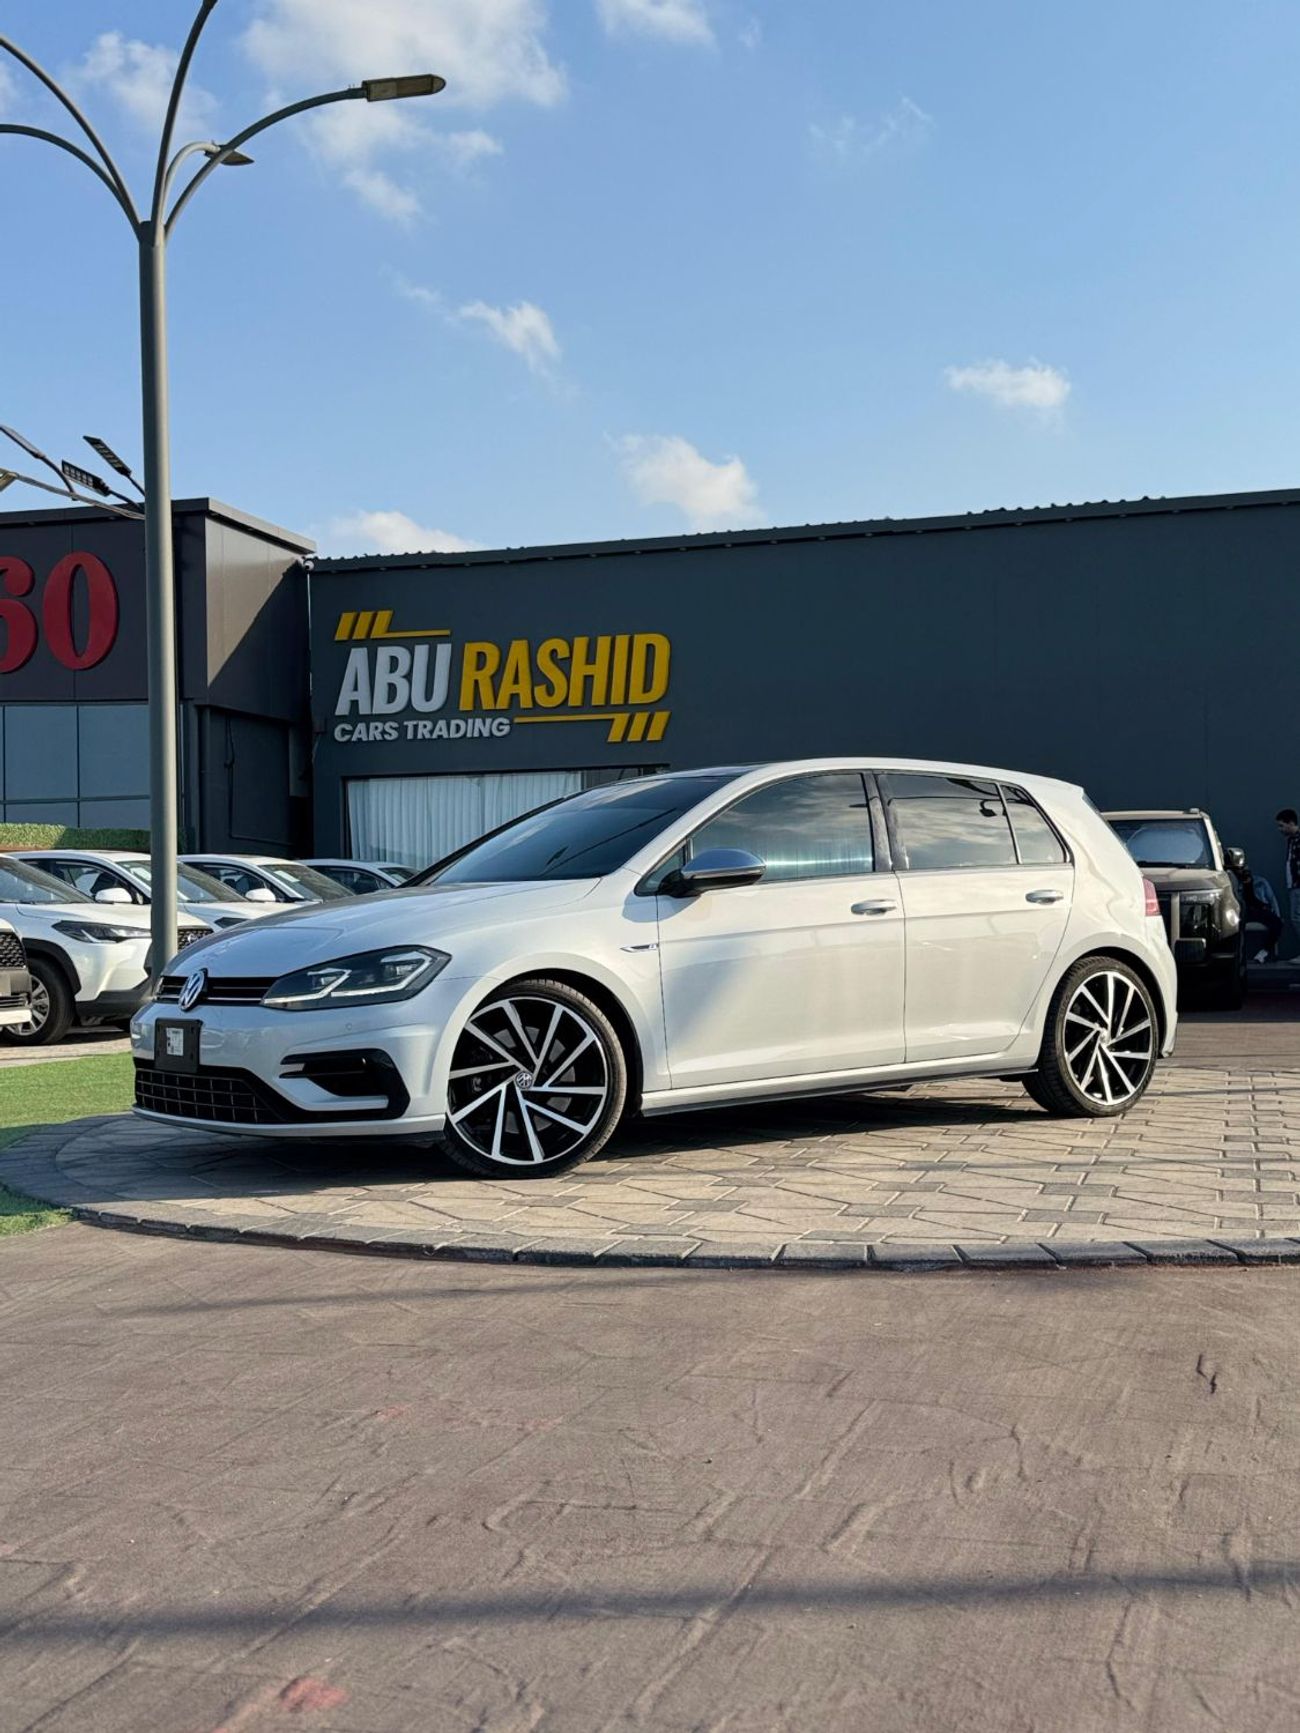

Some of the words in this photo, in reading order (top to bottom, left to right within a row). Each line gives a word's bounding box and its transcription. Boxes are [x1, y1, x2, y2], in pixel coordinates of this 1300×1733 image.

[334, 643, 452, 715] ABU
[459, 633, 671, 711] RASHID
[334, 722, 400, 743] CARS
[405, 718, 511, 740] TRADING
